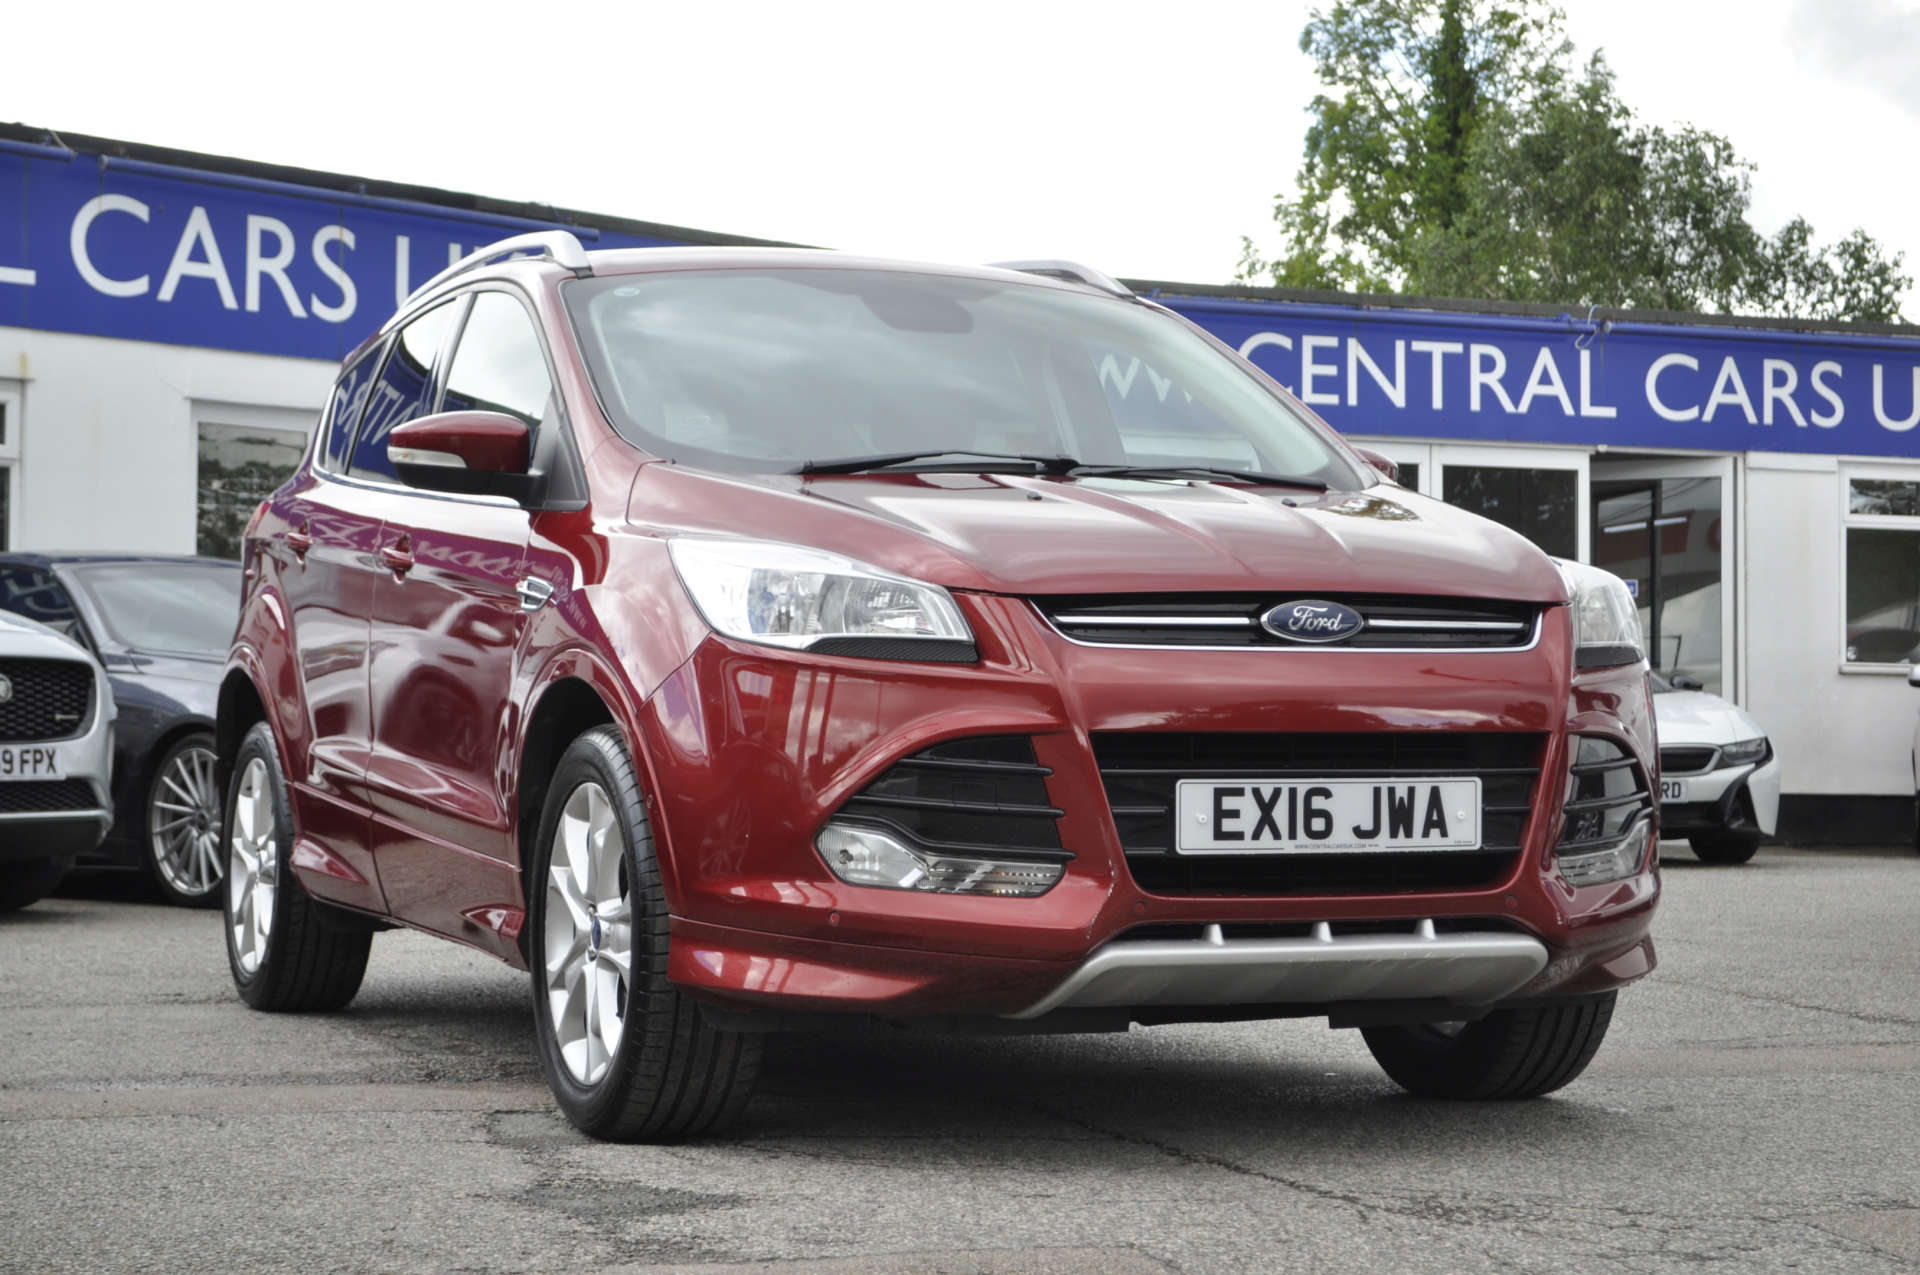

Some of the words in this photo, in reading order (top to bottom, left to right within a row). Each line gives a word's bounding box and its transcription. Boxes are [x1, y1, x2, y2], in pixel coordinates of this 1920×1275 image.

[70, 193, 358, 323] CARS
[1644, 352, 1846, 429] CARS
[1288, 605, 1345, 631] Ford
[19, 748, 57, 774] FPX
[1213, 786, 1334, 841] EX16
[1352, 785, 1449, 840] JWA
